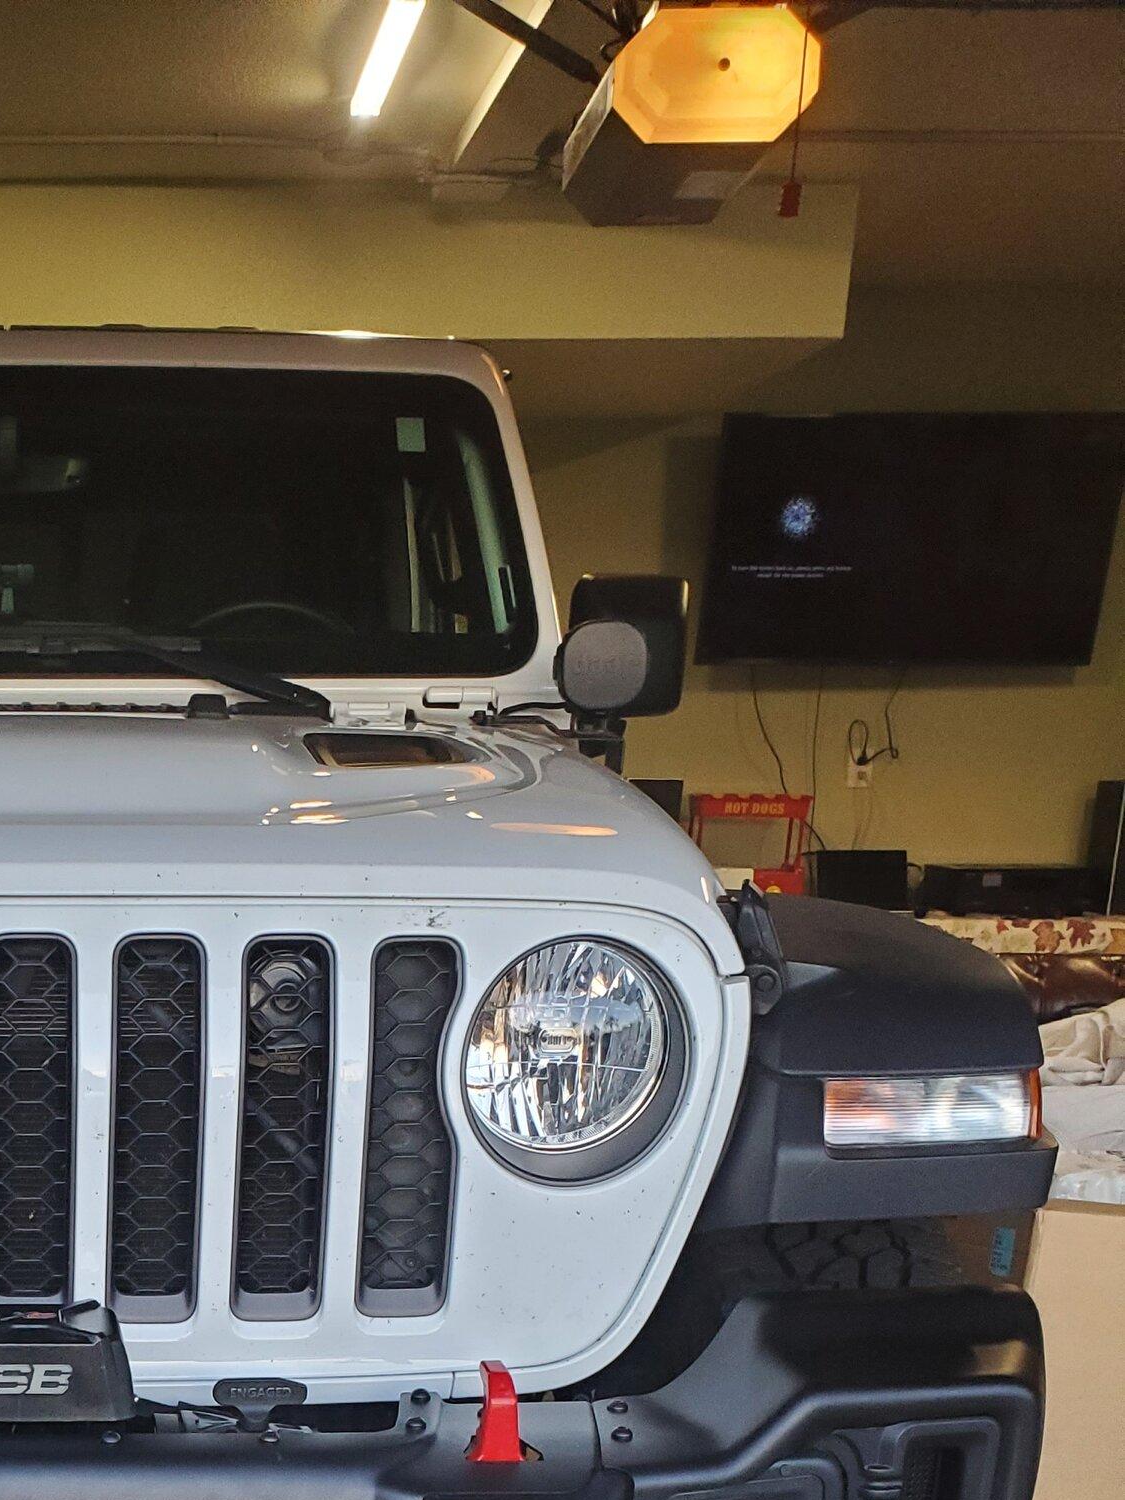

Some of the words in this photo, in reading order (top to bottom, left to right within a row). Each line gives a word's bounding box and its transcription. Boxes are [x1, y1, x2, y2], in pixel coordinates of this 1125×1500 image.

[725, 801, 749, 814] HOT
[752, 802, 785, 815] DOGS
[230, 1386, 293, 1399] ENGAGED
